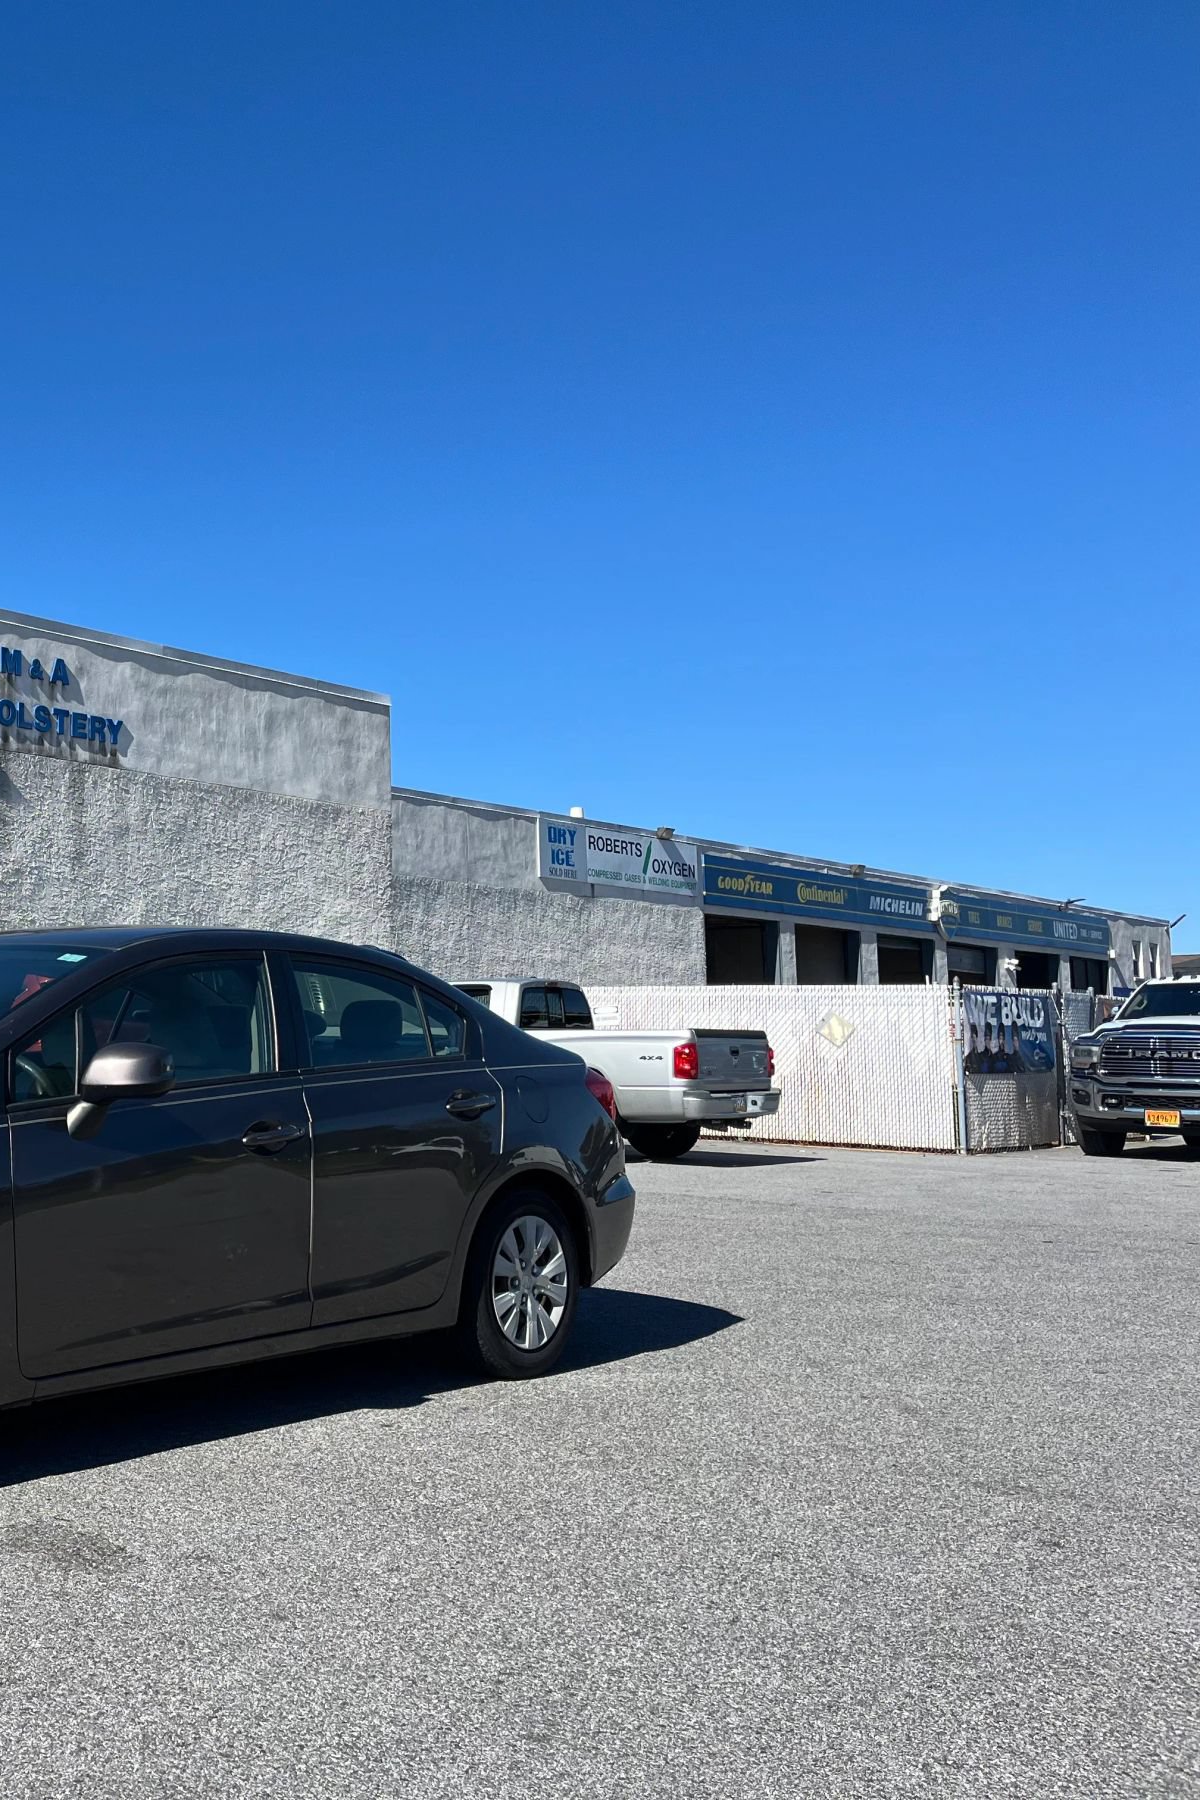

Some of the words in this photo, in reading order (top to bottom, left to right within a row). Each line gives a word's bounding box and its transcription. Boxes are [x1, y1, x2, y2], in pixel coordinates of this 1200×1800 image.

[1, 646, 22, 677] M
[29, 658, 44, 680] &
[50, 657, 70, 686] A
[547, 826, 577, 846] DRY
[588, 835, 642, 858] ROBERTS
[551, 847, 575, 867] ICE
[549, 867, 563, 877] SOLD
[588, 868, 623, 880] COMPRESSED
[624, 873, 641, 883] GASES
[649, 876, 670, 887] WELDING
[652, 859, 696, 878] OXYGEN
[718, 874, 773, 895] GOODYEAR
[797, 883, 845, 904] Continental
[869, 895, 923, 916] MICHELIN
[1053, 920, 1078, 940] UNITED
[968, 994, 997, 1025] WE
[1001, 995, 1044, 1028] BUILD
[1135, 1050, 1188, 1058] RAM
